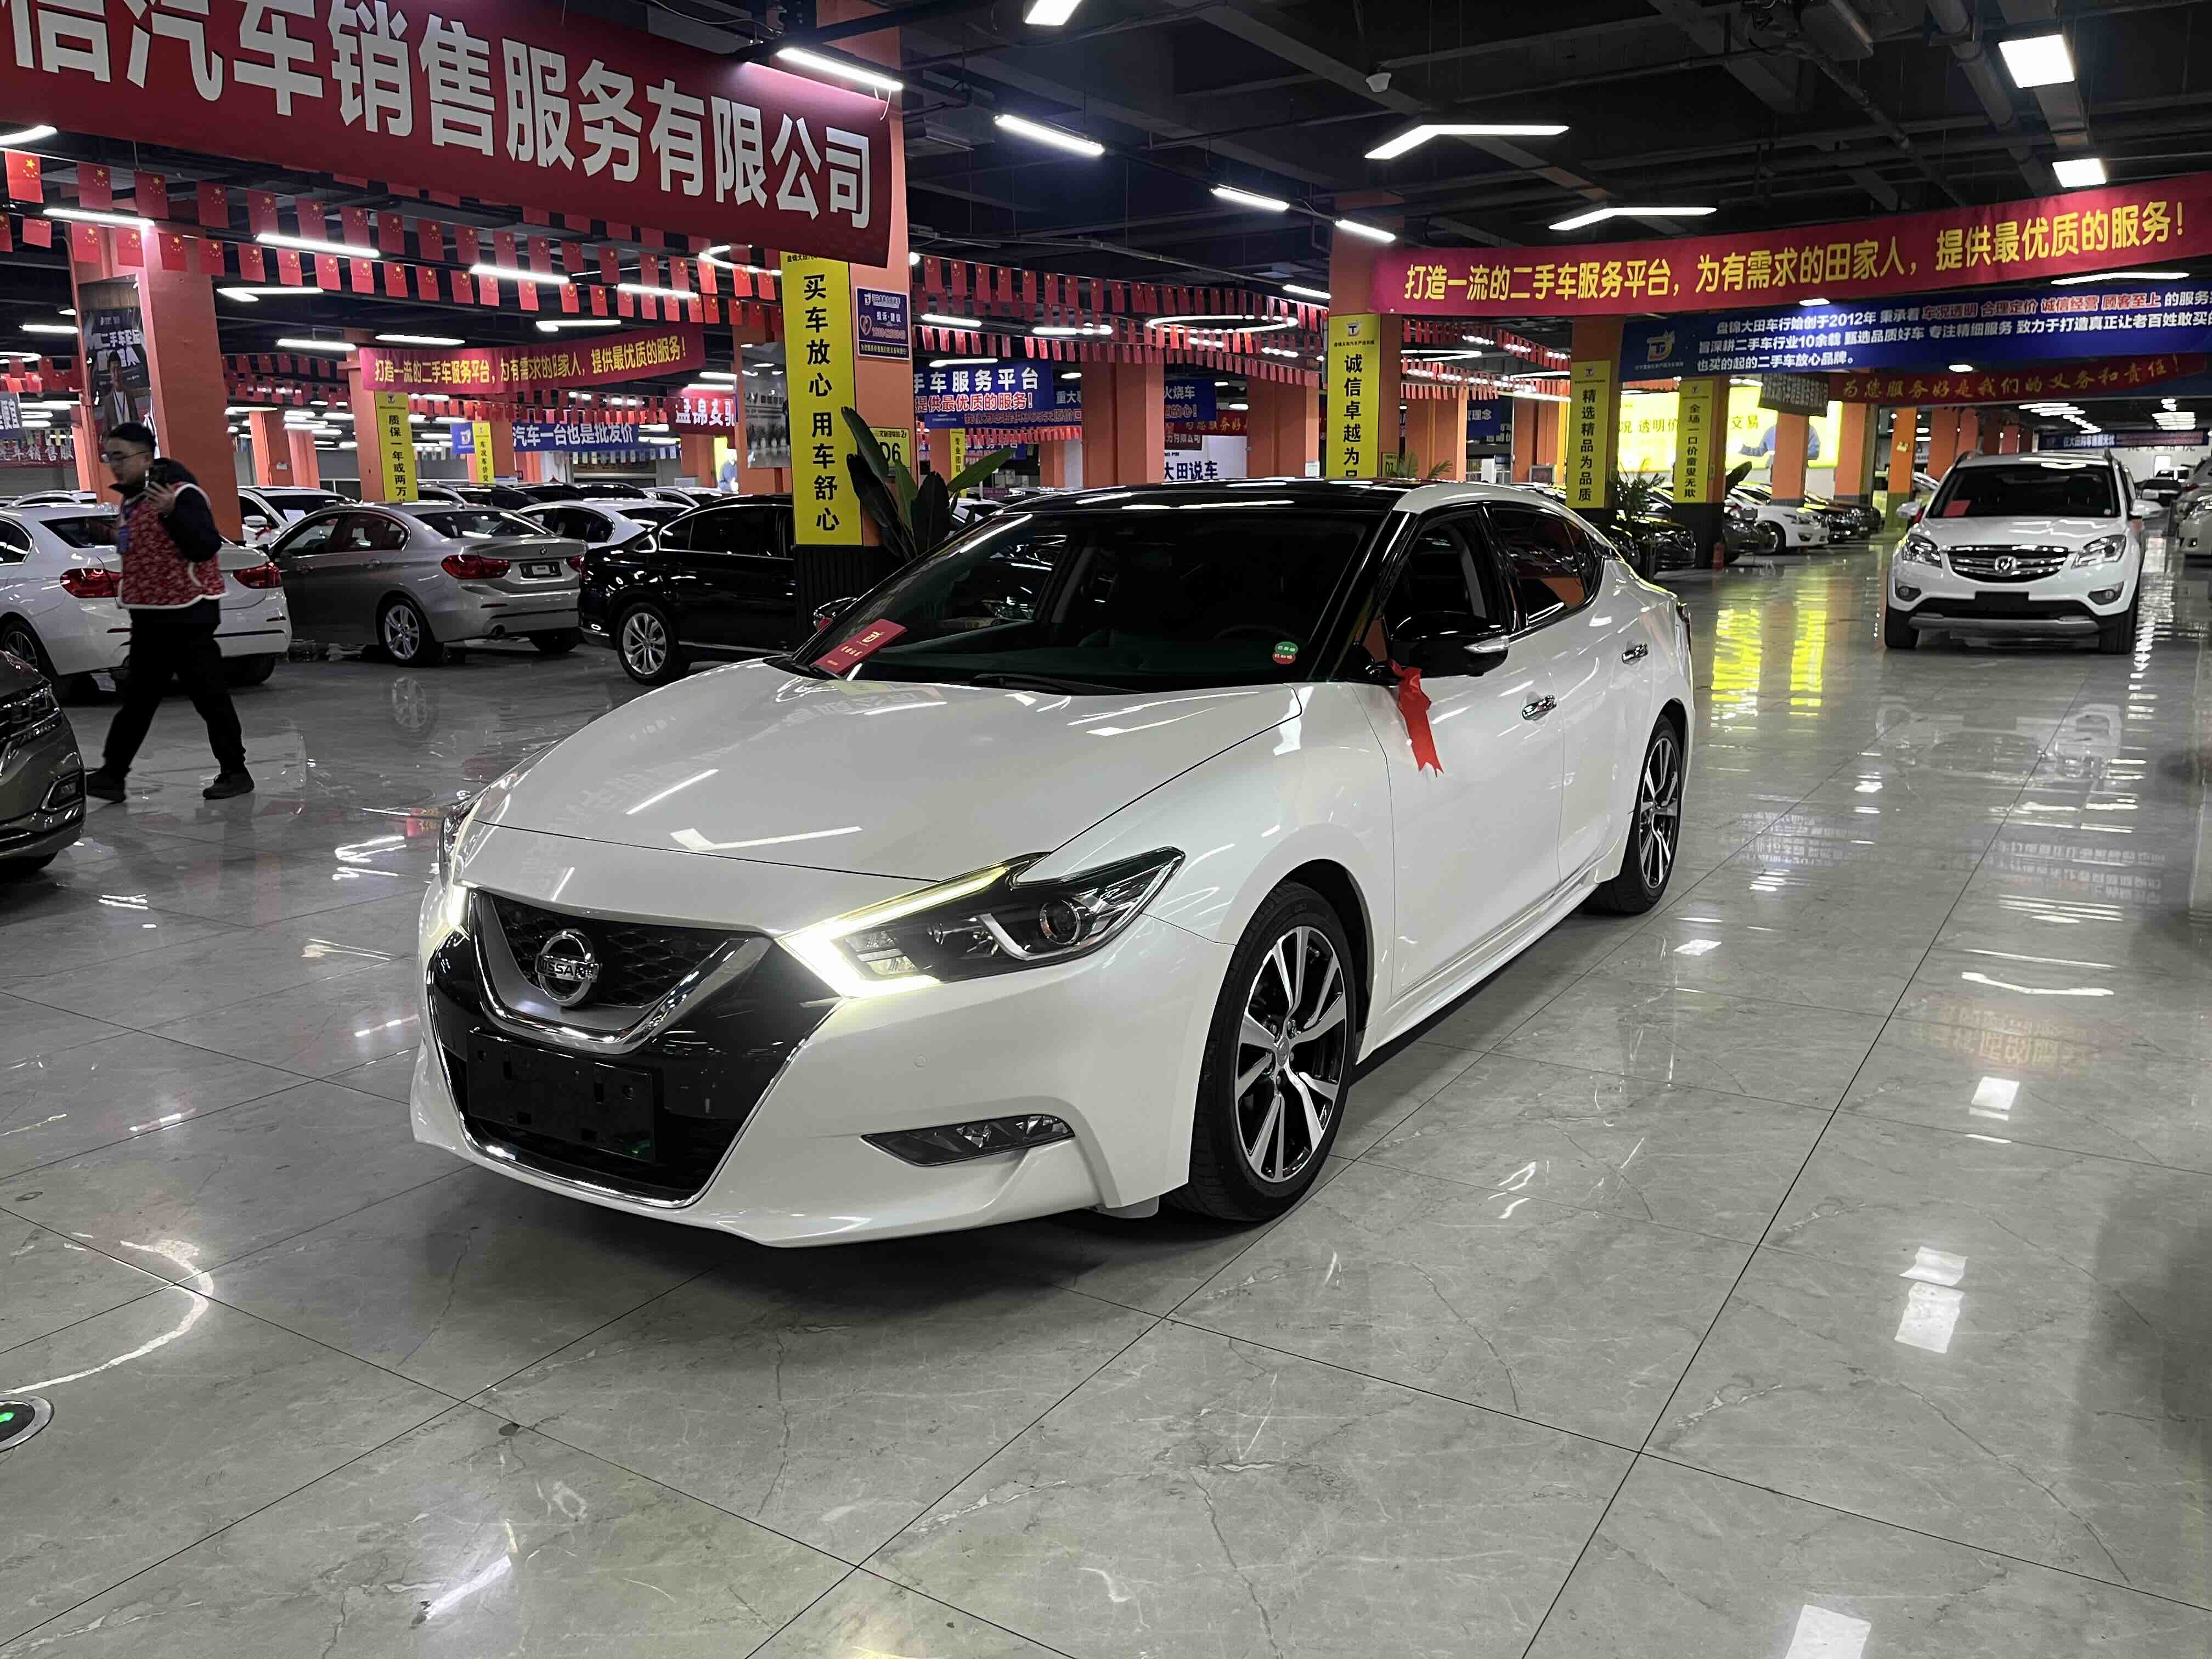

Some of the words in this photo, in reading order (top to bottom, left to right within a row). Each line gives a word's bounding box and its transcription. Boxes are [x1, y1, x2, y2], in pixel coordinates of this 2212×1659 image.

[2040, 295, 2100, 314] 诚信经营
[2101, 292, 2162, 311] 顾客至上
[2164, 291, 2212, 307] 的服务
[1730, 413, 1759, 430] 交易
[512, 422, 633, 447] 汽车一台也是批发价
[1578, 388, 1596, 501] 精选精品为品质
[1164, 460, 1218, 481] 大田说车
